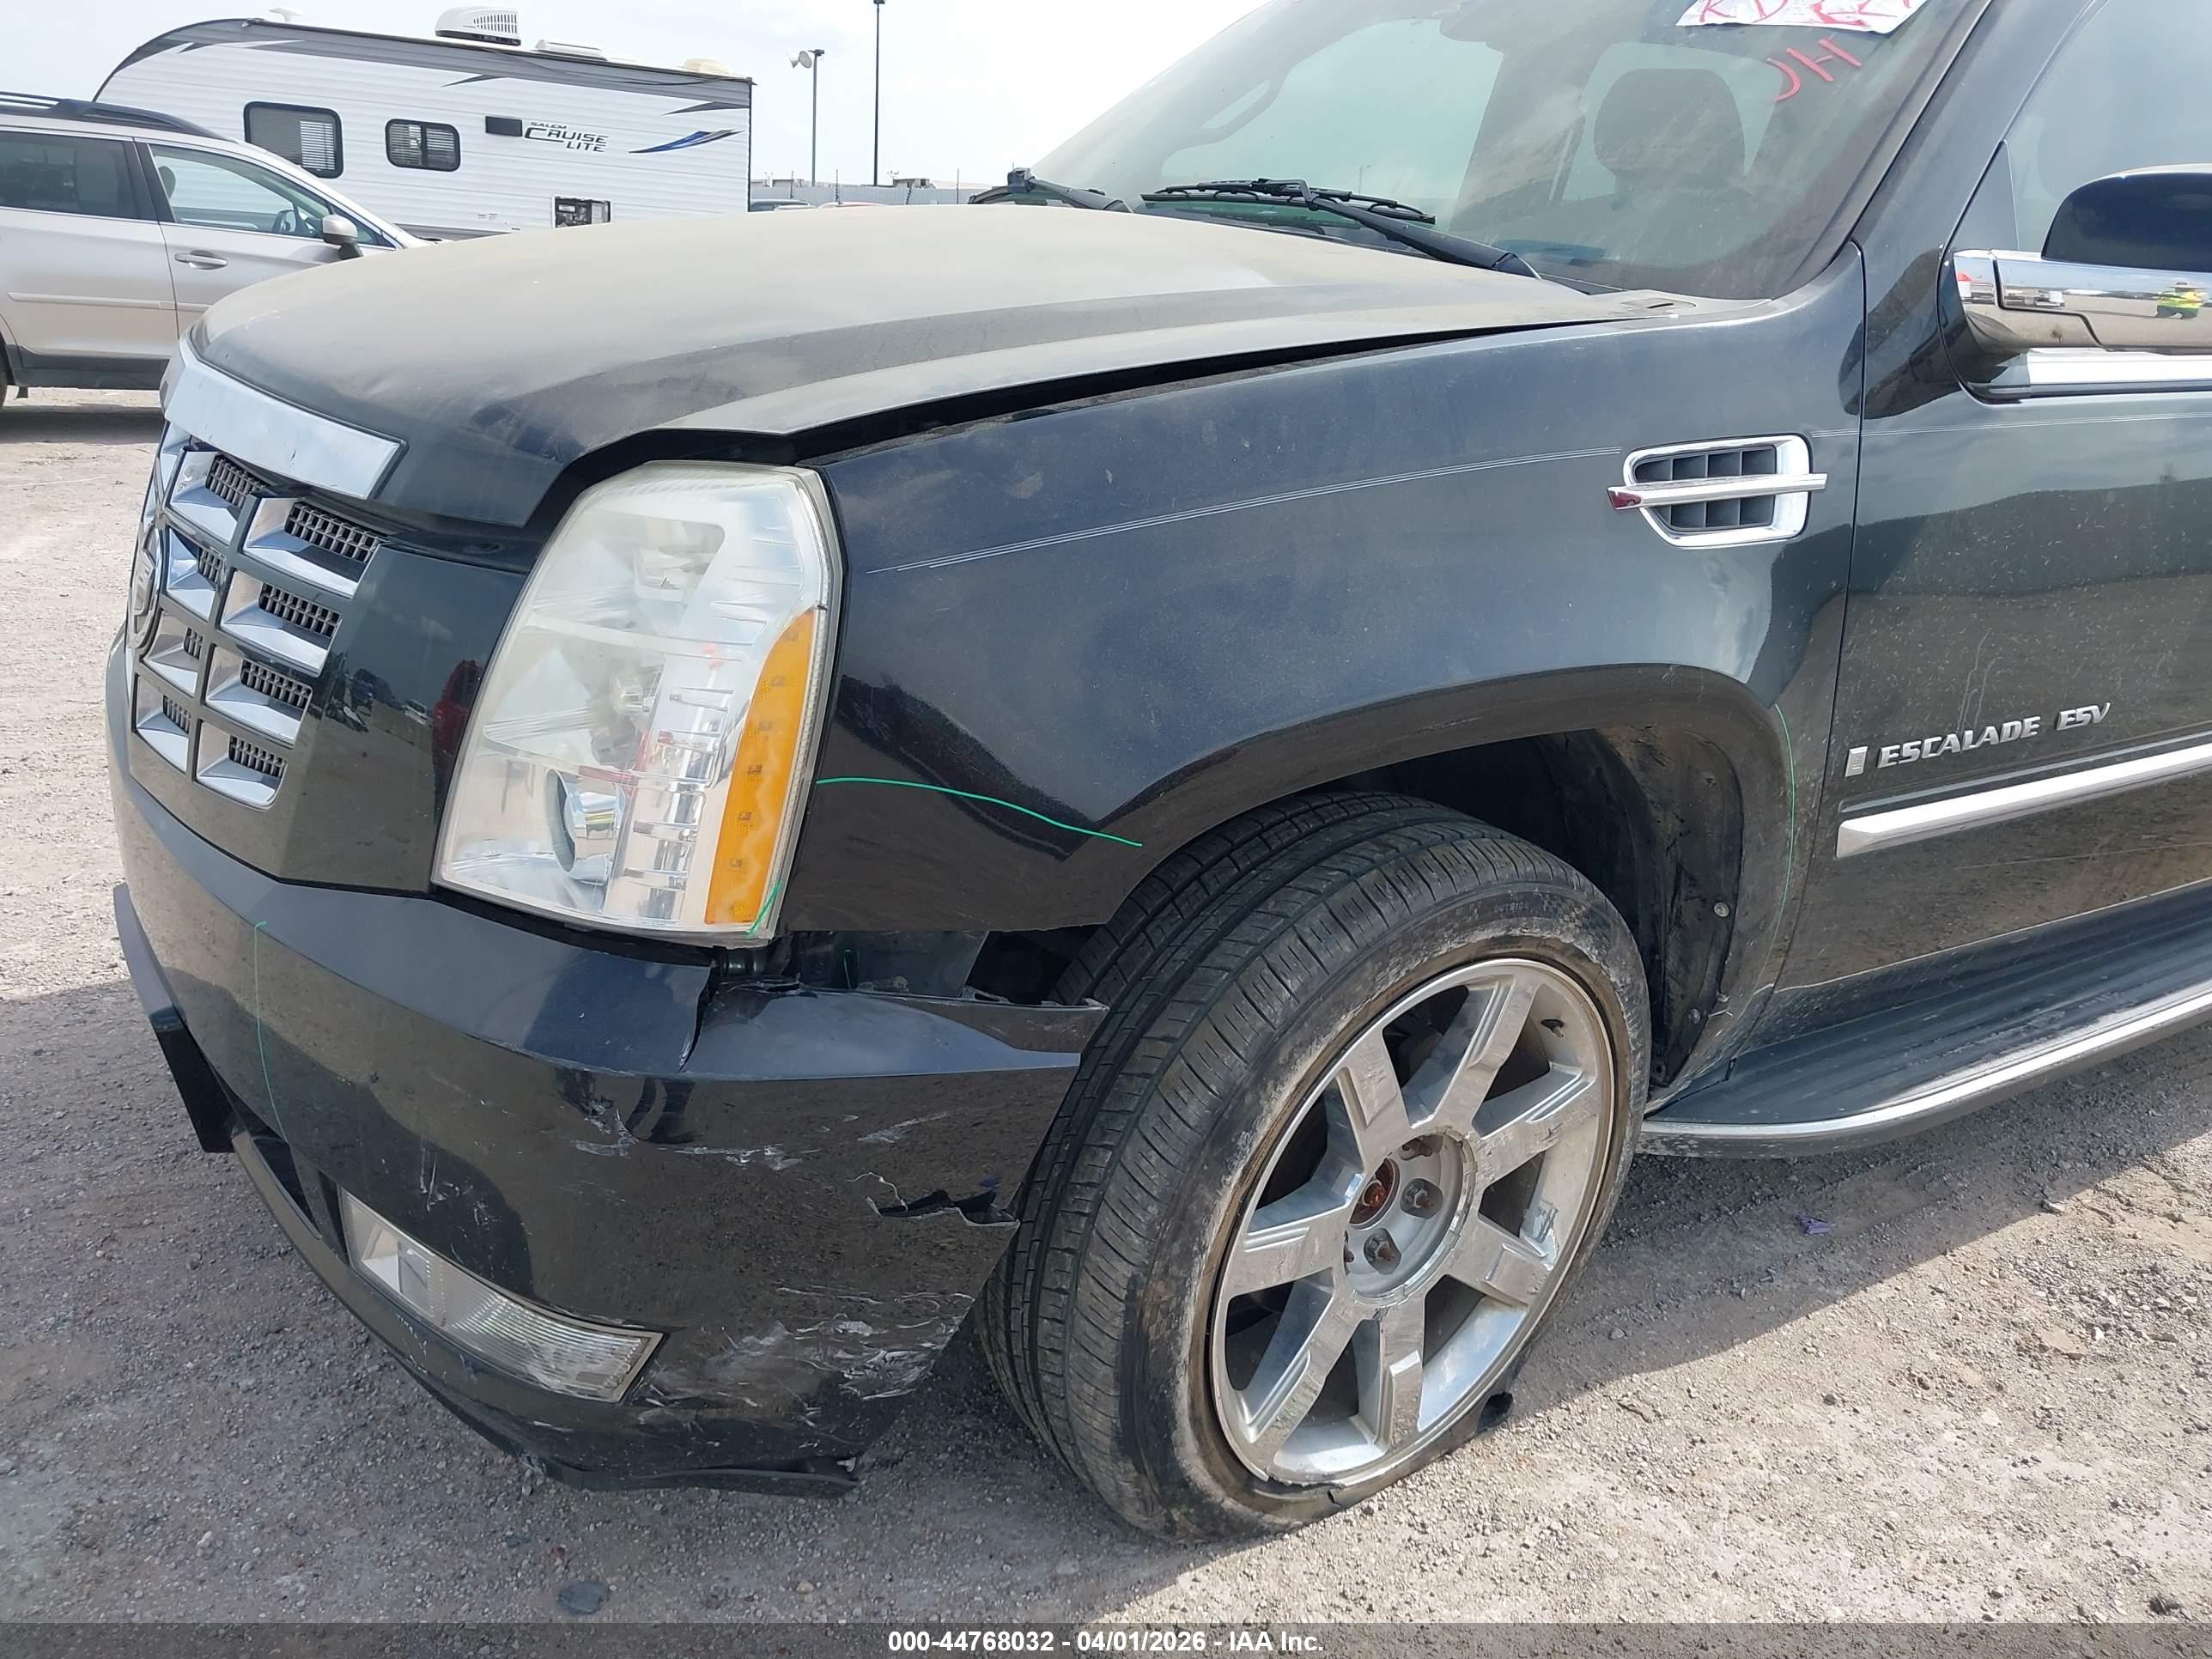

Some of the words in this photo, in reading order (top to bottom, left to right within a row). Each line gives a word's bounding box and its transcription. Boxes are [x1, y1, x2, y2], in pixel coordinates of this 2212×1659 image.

[524, 127, 610, 143] CRUISE
[566, 141, 606, 152] LITE
[1877, 716, 2041, 769] ESCALADE
[2057, 702, 2111, 731] ESV
